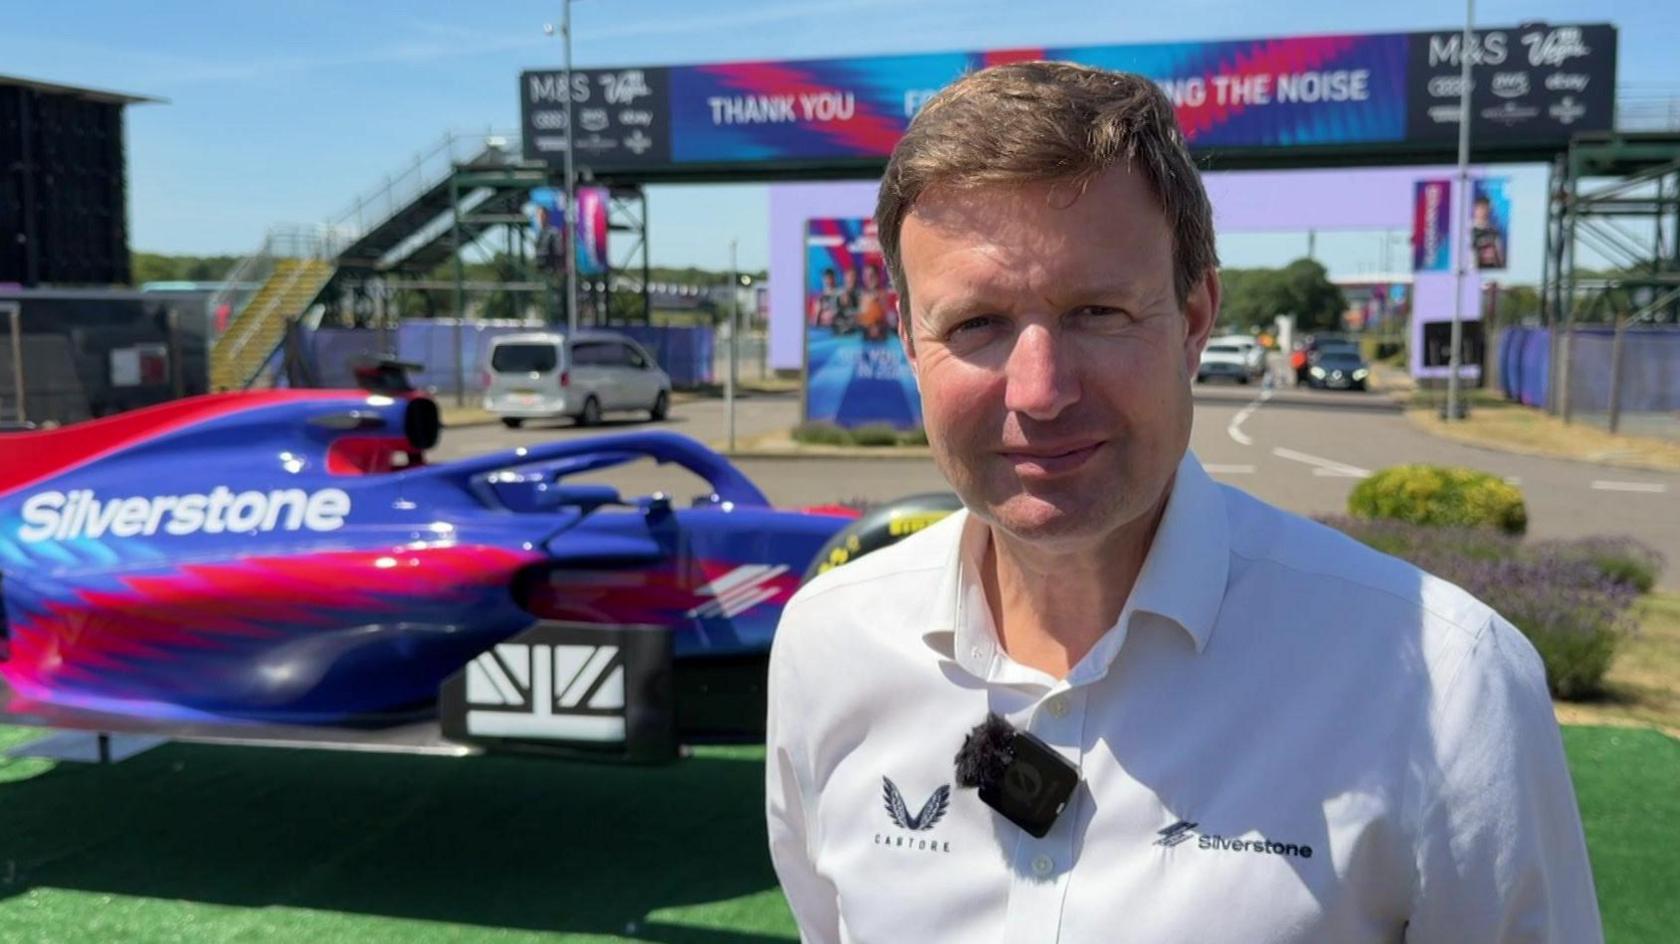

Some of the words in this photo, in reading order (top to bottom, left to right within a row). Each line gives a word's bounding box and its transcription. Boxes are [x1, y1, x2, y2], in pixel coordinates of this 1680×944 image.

[1429, 31, 1507, 67] M&S
[709, 94, 796, 126] THANK
[800, 92, 855, 121] YOU
[1211, 73, 1273, 106] THE
[1277, 69, 1369, 104] NOISE
[18, 485, 351, 543] Silverstone
[1197, 832, 1313, 859] Silverstone
